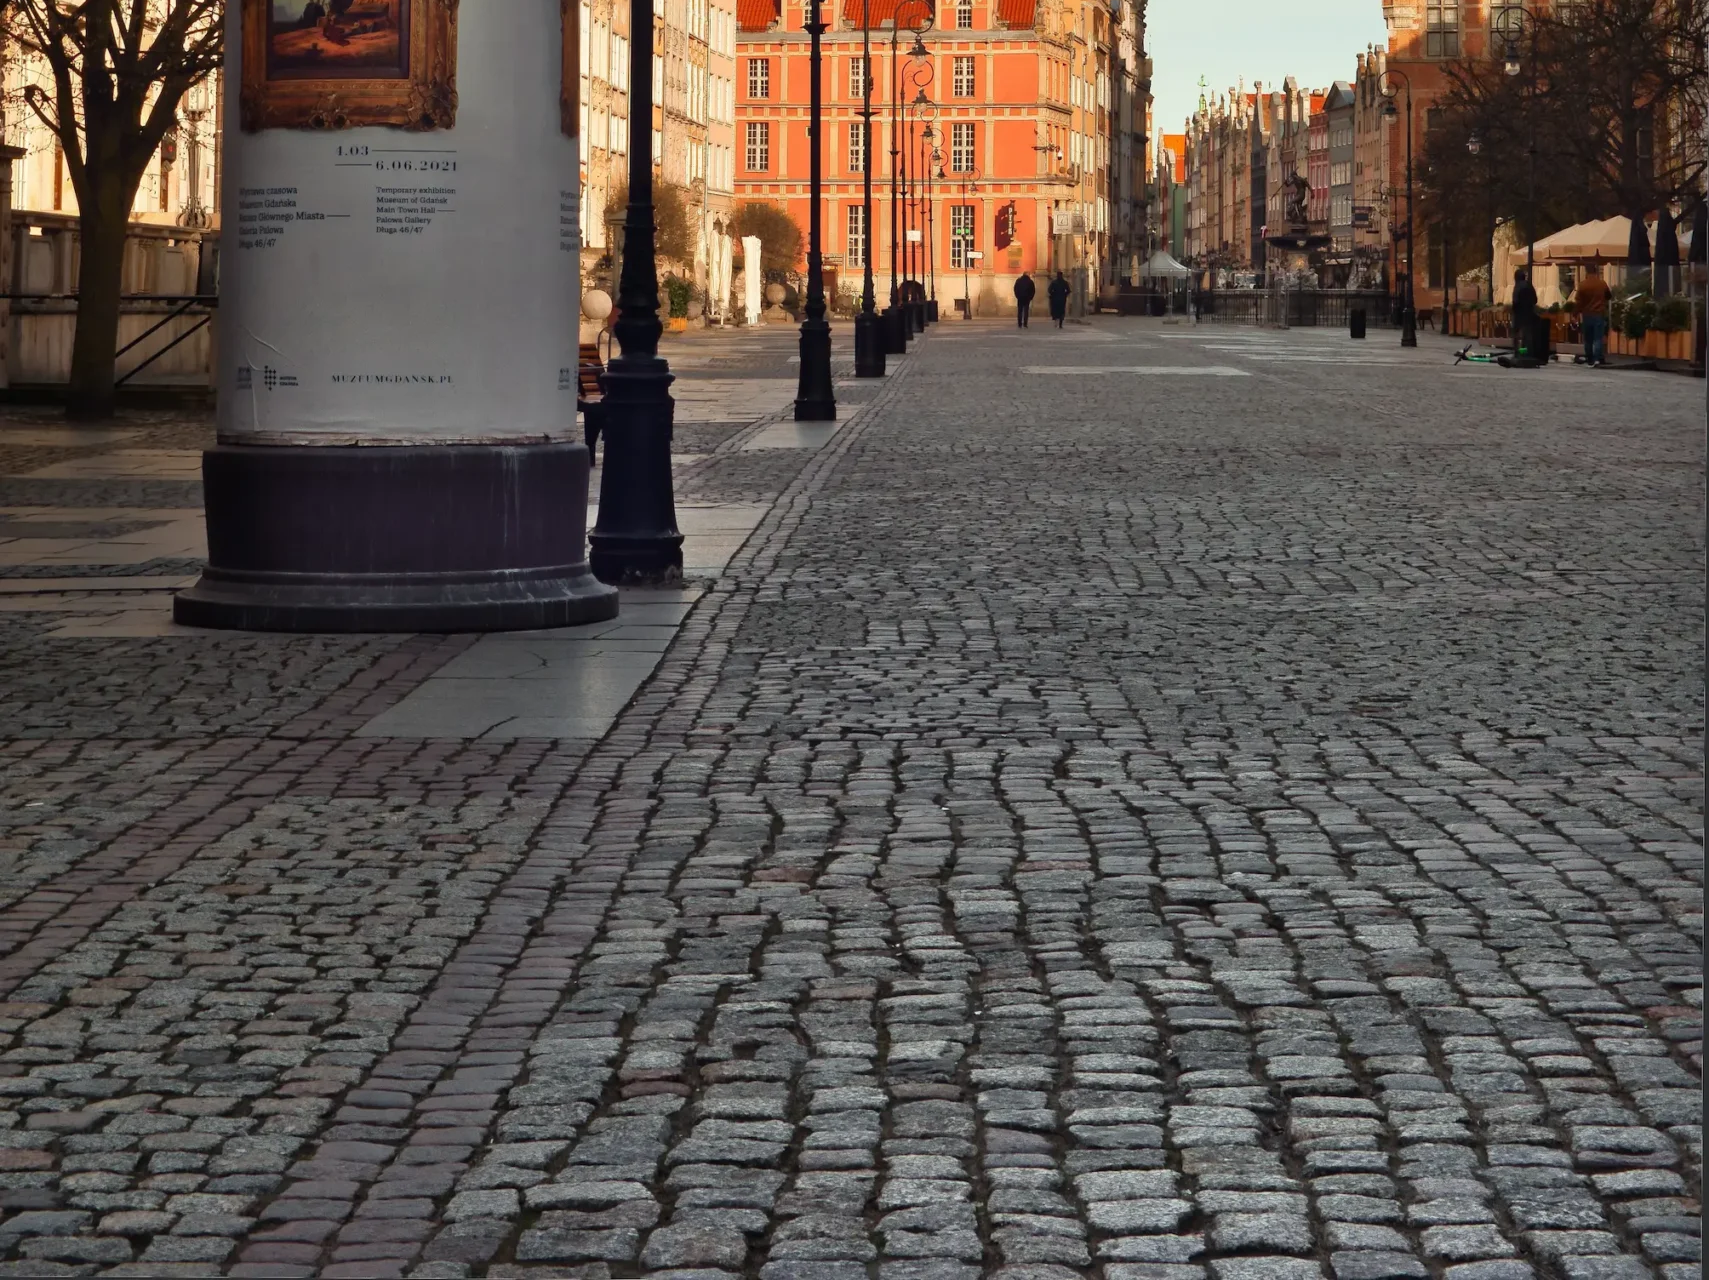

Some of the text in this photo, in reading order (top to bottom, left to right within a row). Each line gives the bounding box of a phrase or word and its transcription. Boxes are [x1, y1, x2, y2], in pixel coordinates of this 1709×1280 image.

[375, 160, 457, 172] 6.06.2021
[266, 187, 298, 195] czasowa
[375, 186, 456, 195] Temporary exhibition
[376, 197, 409, 205] Museum
[410, 197, 418, 205] of
[376, 206, 436, 214] Main Town Hall
[296, 212, 325, 220] Miasta
[404, 216, 432, 226] Gallery
